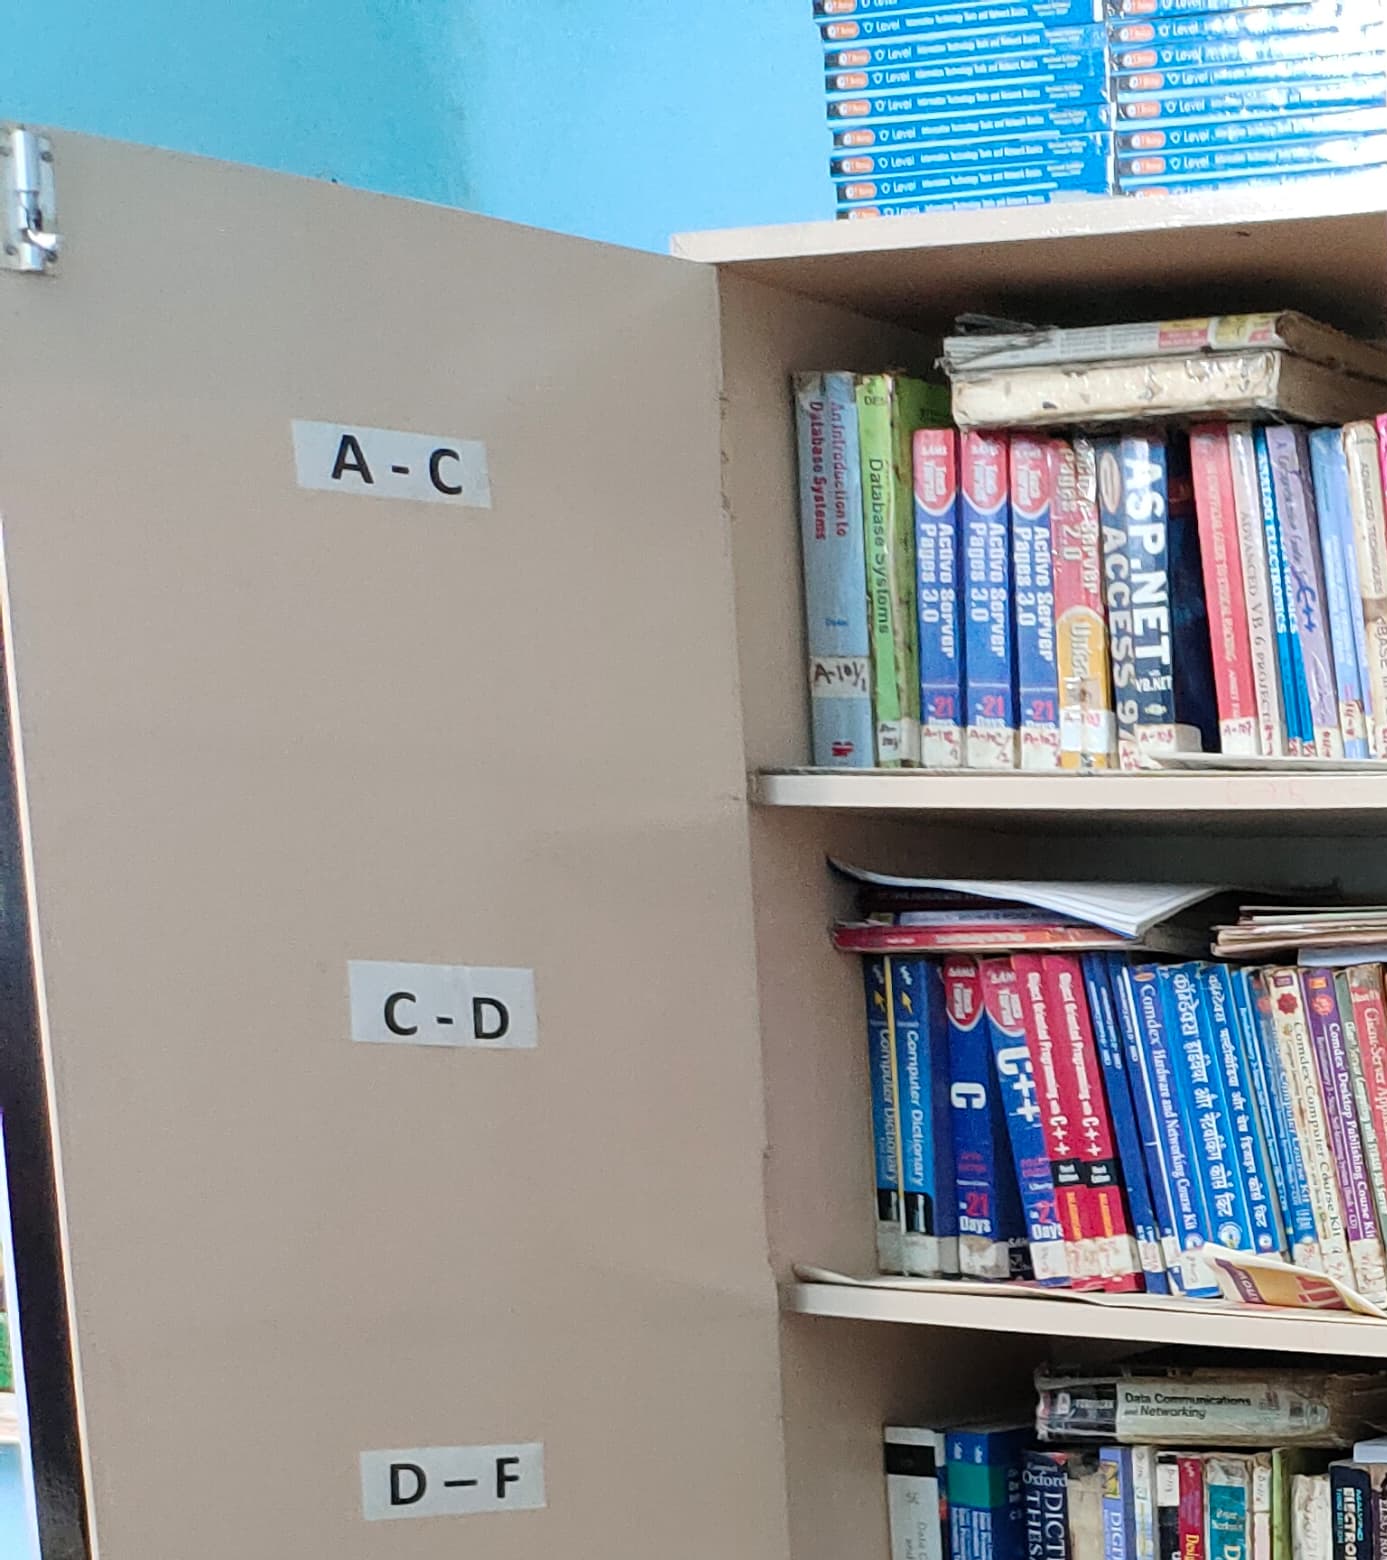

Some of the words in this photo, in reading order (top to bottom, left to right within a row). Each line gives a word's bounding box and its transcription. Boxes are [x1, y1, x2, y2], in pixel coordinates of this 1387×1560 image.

[869, 458, 886, 547] Database
[951, 1082, 986, 1110] C
[1124, 1393, 1152, 1404] Data
[1155, 1393, 1251, 1407] Communications
[1140, 1405, 1207, 1420] Networking
[1022, 1471, 1068, 1489] Oxford
